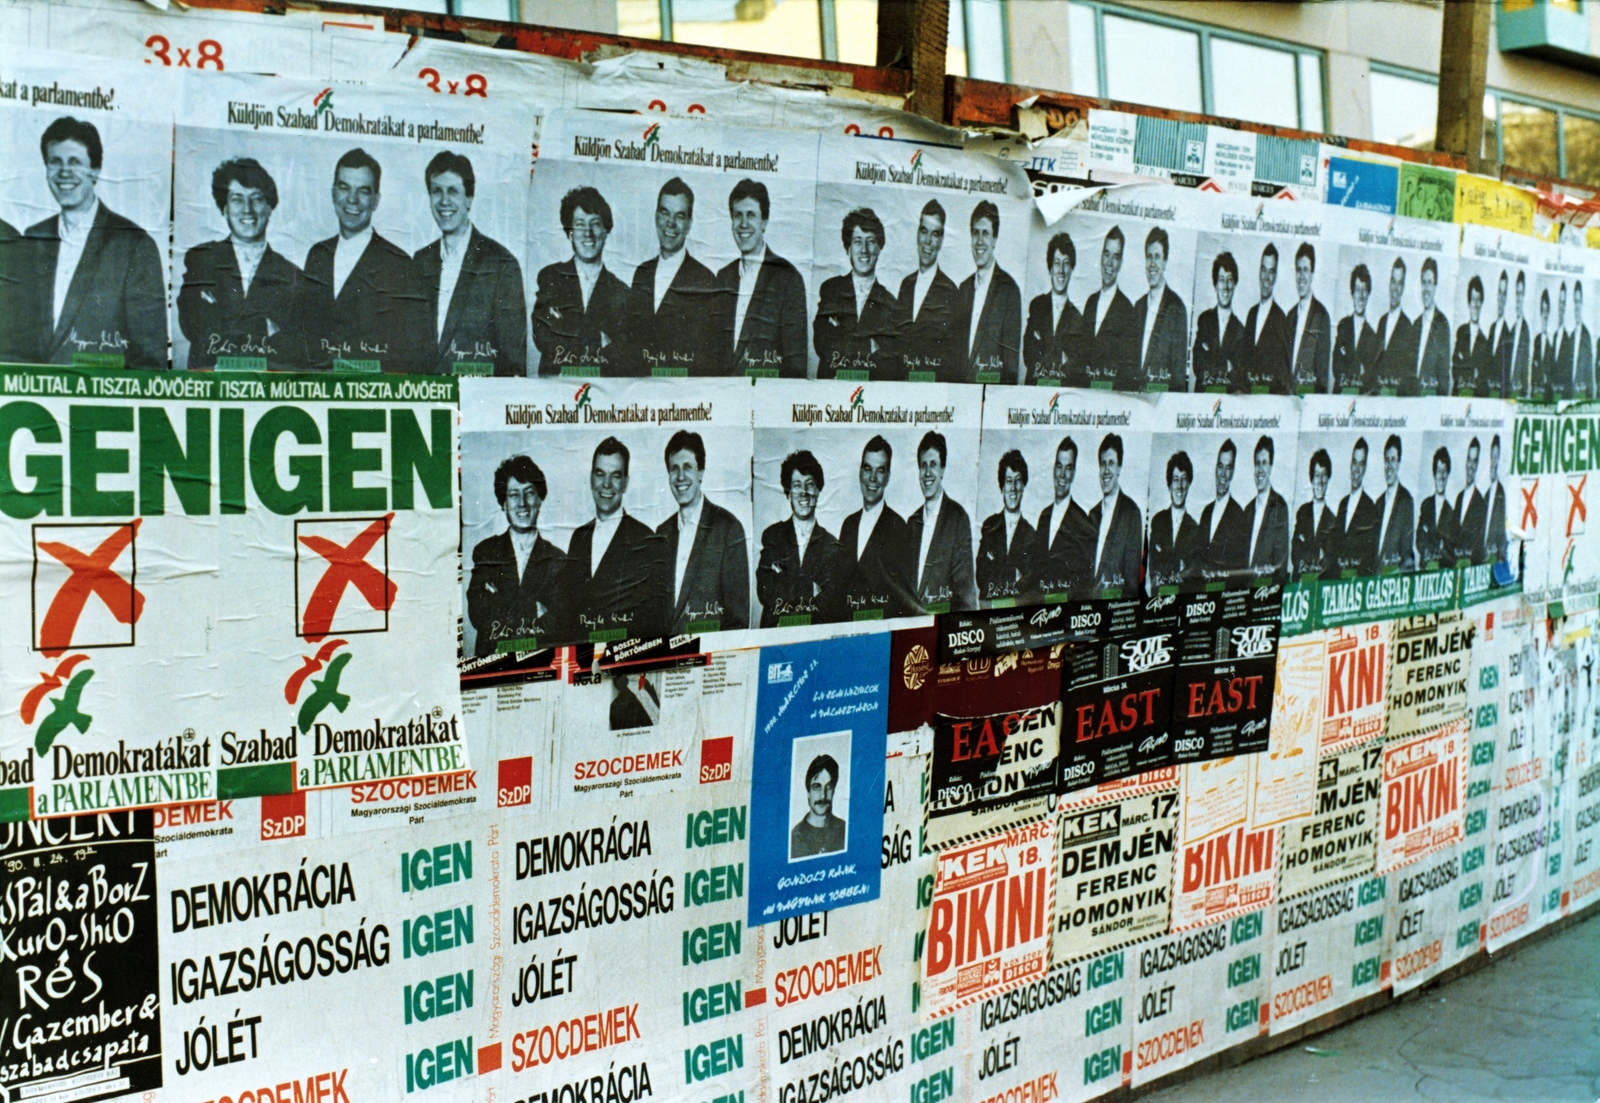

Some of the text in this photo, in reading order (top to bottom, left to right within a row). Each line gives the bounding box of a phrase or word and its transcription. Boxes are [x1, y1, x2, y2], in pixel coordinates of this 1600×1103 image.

[227, 100, 486, 145] Küldjön Szabad Demokratákat a parlamentbe!
[574, 135, 611, 162] Küldjön
[614, 139, 646, 162] Szabad
[650, 142, 714, 168] Demokratákat
[4, 373, 214, 398] MÚLTTAL A TISZTA JÖVŐÉRT
[270, 379, 331, 400] MÚLTTAL
[334, 384, 345, 400] A
[347, 382, 394, 400] TISZTA
[395, 381, 454, 400] JÖVŐÉRT
[505, 402, 713, 429] Küldjön Szabad Demokratákat a parlamentbe!
[824, 404, 853, 423] Szabad
[218, 405, 454, 516] IGEN
[1510, 416, 1554, 476] IGEN
[1070, 612, 1101, 630] DISCO
[1186, 601, 1215, 618] DISCO
[948, 628, 985, 648] DISCO
[1396, 626, 1473, 665] DEMJÉN
[1328, 643, 1386, 718] KINI
[1406, 658, 1461, 685] FERENC
[1187, 675, 1263, 718] EAST
[1393, 678, 1468, 711] HOMONYIK
[1075, 688, 1161, 744] EAST
[220, 713, 461, 767] Szabad Demokratákat
[1174, 737, 1205, 753] DISCO
[299, 746, 467, 787] a PARLAMENTBE
[574, 749, 683, 781] SZOCDEMEK
[701, 762, 731, 782] SzDP
[1064, 761, 1095, 781] DISCO
[37, 770, 214, 815] a PARLAMENTBE
[351, 770, 478, 805] SZOCDEMEK
[499, 784, 532, 806] SzDP
[620, 788, 634, 800] Párt
[1384, 756, 1459, 842] BIKINI
[154, 826, 234, 845] Szociáldemokrata
[262, 804, 306, 839] SzDP
[409, 815, 425, 826] Párt
[686, 804, 747, 849] IGEN
[1064, 808, 1119, 841] KEK
[1301, 809, 1366, 843] FERENC
[401, 840, 473, 893] IGEN
[515, 814, 652, 881] DEMOKRÁCIA
[944, 843, 1007, 881] KEK
[1018, 846, 1042, 868] 18.
[1061, 827, 1174, 879] DEMJÉN
[1182, 826, 1275, 895] BIKINI
[1286, 830, 1375, 870] HOMONYIK
[171, 857, 357, 934] DEMOKRÁCIA
[1077, 863, 1157, 901] FERENC
[1357, 876, 1386, 908] IGEN
[513, 868, 675, 945] IGAZSÁGOSSÁG
[926, 866, 1047, 978] BIKINI
[1058, 886, 1168, 934] HOMONYIK
[1091, 916, 1134, 937] SÁNDOR
[1230, 910, 1264, 947] IGEN
[171, 916, 390, 1006] IGAZSÁGOSSÁG
[511, 947, 578, 1008] JÓLÉT
[774, 944, 882, 1008] SZOCDEMEK
[1086, 950, 1125, 992] IGEN
[1137, 980, 1176, 1025] JÓLÉT
[175, 1008, 262, 1076] JÓLÉT
[511, 1002, 641, 1073] SZOCDEMEK
[778, 995, 887, 1065] DEMOKRÁCIA
[911, 1016, 954, 1064] IGEN
[406, 1035, 475, 1093] IGEN
[978, 1031, 1021, 1081] JÓLÉT
